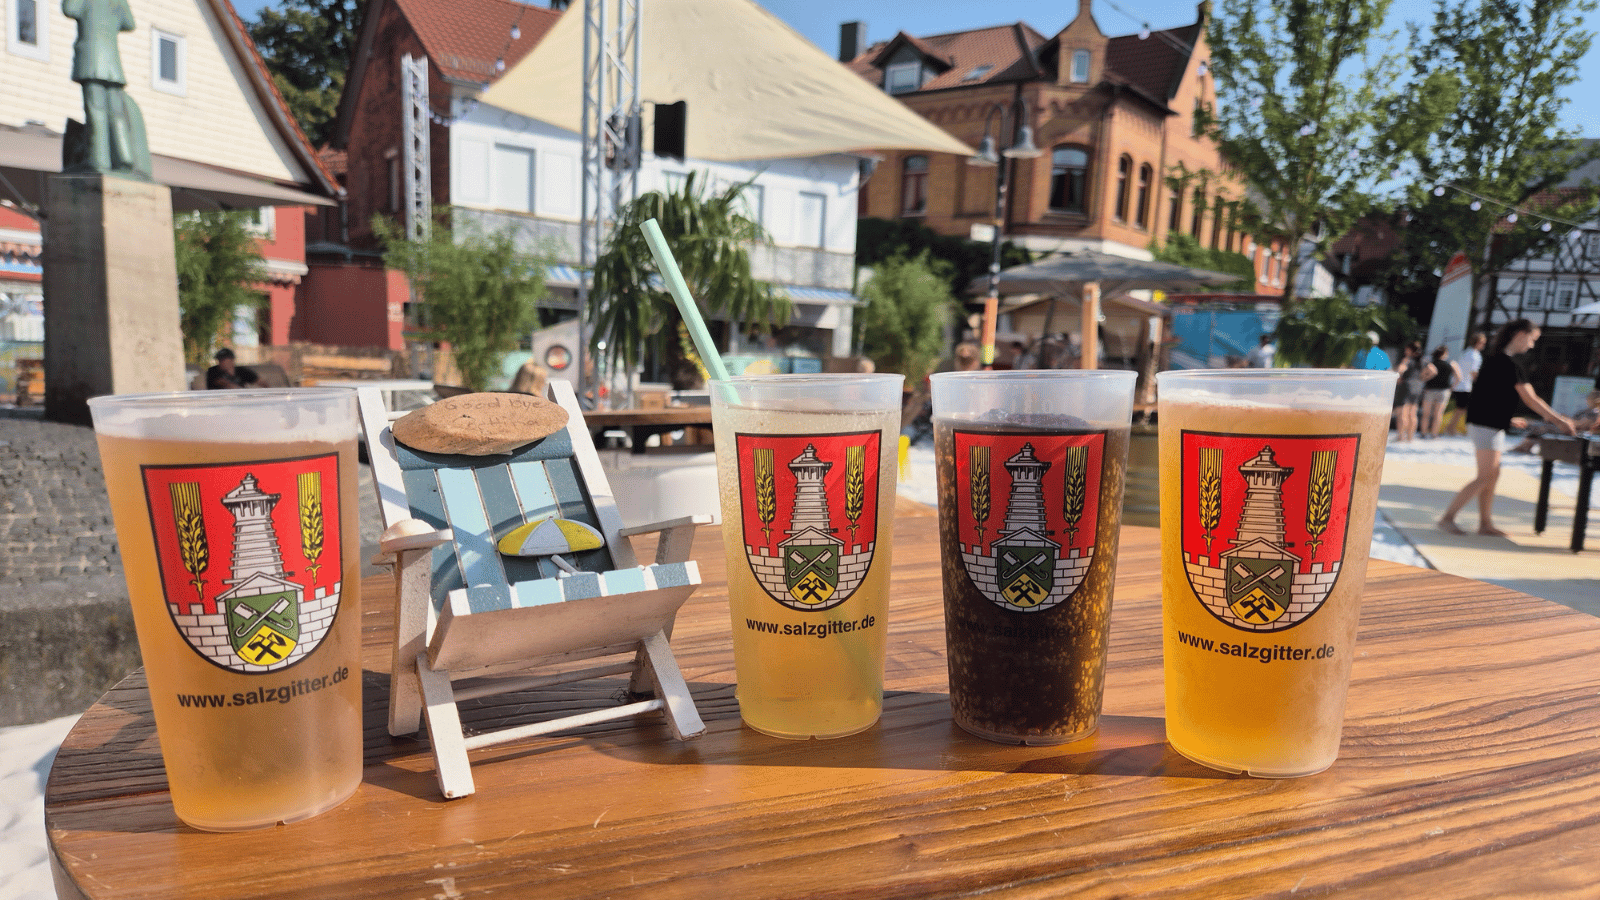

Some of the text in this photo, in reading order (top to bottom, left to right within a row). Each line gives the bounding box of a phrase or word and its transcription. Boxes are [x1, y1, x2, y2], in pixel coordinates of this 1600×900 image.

[746, 614, 875, 639] www.salzgitter.de
[1179, 631, 1335, 664] www.salzgitter.de
[177, 666, 349, 708] www.salzgitter.de
